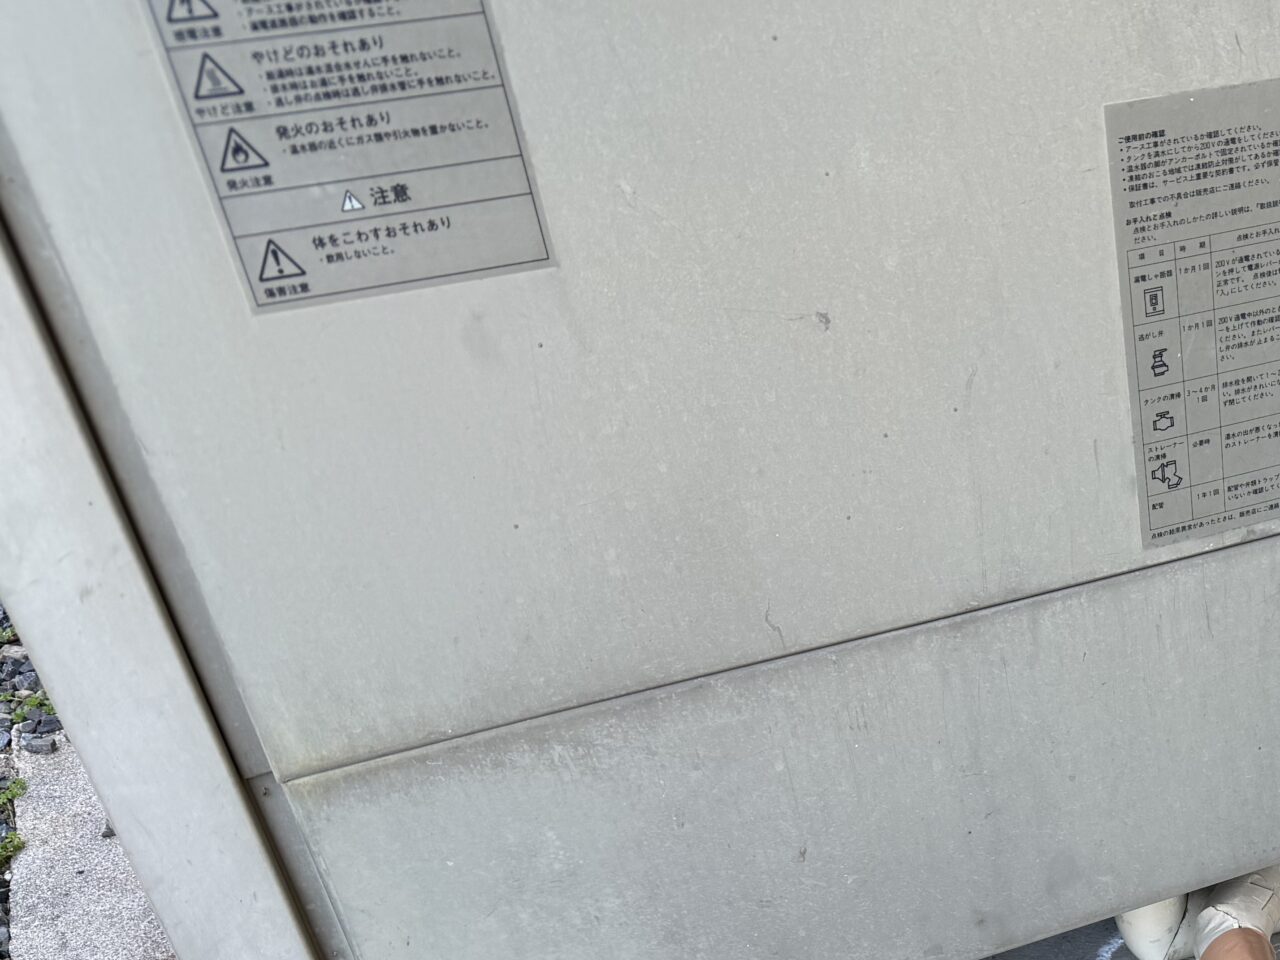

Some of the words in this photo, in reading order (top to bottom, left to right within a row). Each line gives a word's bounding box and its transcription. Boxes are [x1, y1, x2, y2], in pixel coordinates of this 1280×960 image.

[250, 34, 385, 63] やけどのおそれあり
[194, 101, 255, 119] やけど注意
[274, 111, 392, 140] 発火のおそれあり
[1118, 129, 1166, 144] ご使用前の確認
[225, 173, 275, 191] 発火注意
[368, 182, 412, 206] 注意
[1125, 210, 1171, 226] お手入れと点検
[310, 215, 452, 250] 体をこわすおそれあり
[1133, 233, 1157, 244] ださい。
[1178, 262, 1209, 275] 1か月1回
[262, 281, 311, 300] 傷害注意
[1182, 319, 1212, 332] 1か月1回
[1138, 329, 1164, 342] 逃がし弁
[1219, 352, 1235, 362] さい。
[1143, 391, 1181, 406] タンクの清掃
[1196, 394, 1207, 404] 1回
[1222, 389, 1274, 408] ず閉じてください。
[1147, 439, 1184, 453] ストレーナー
[1191, 438, 1210, 448] 必要時
[1148, 452, 1166, 463] の清掃
[1196, 488, 1219, 500] 1年1回
[1151, 502, 1164, 511] 配管
